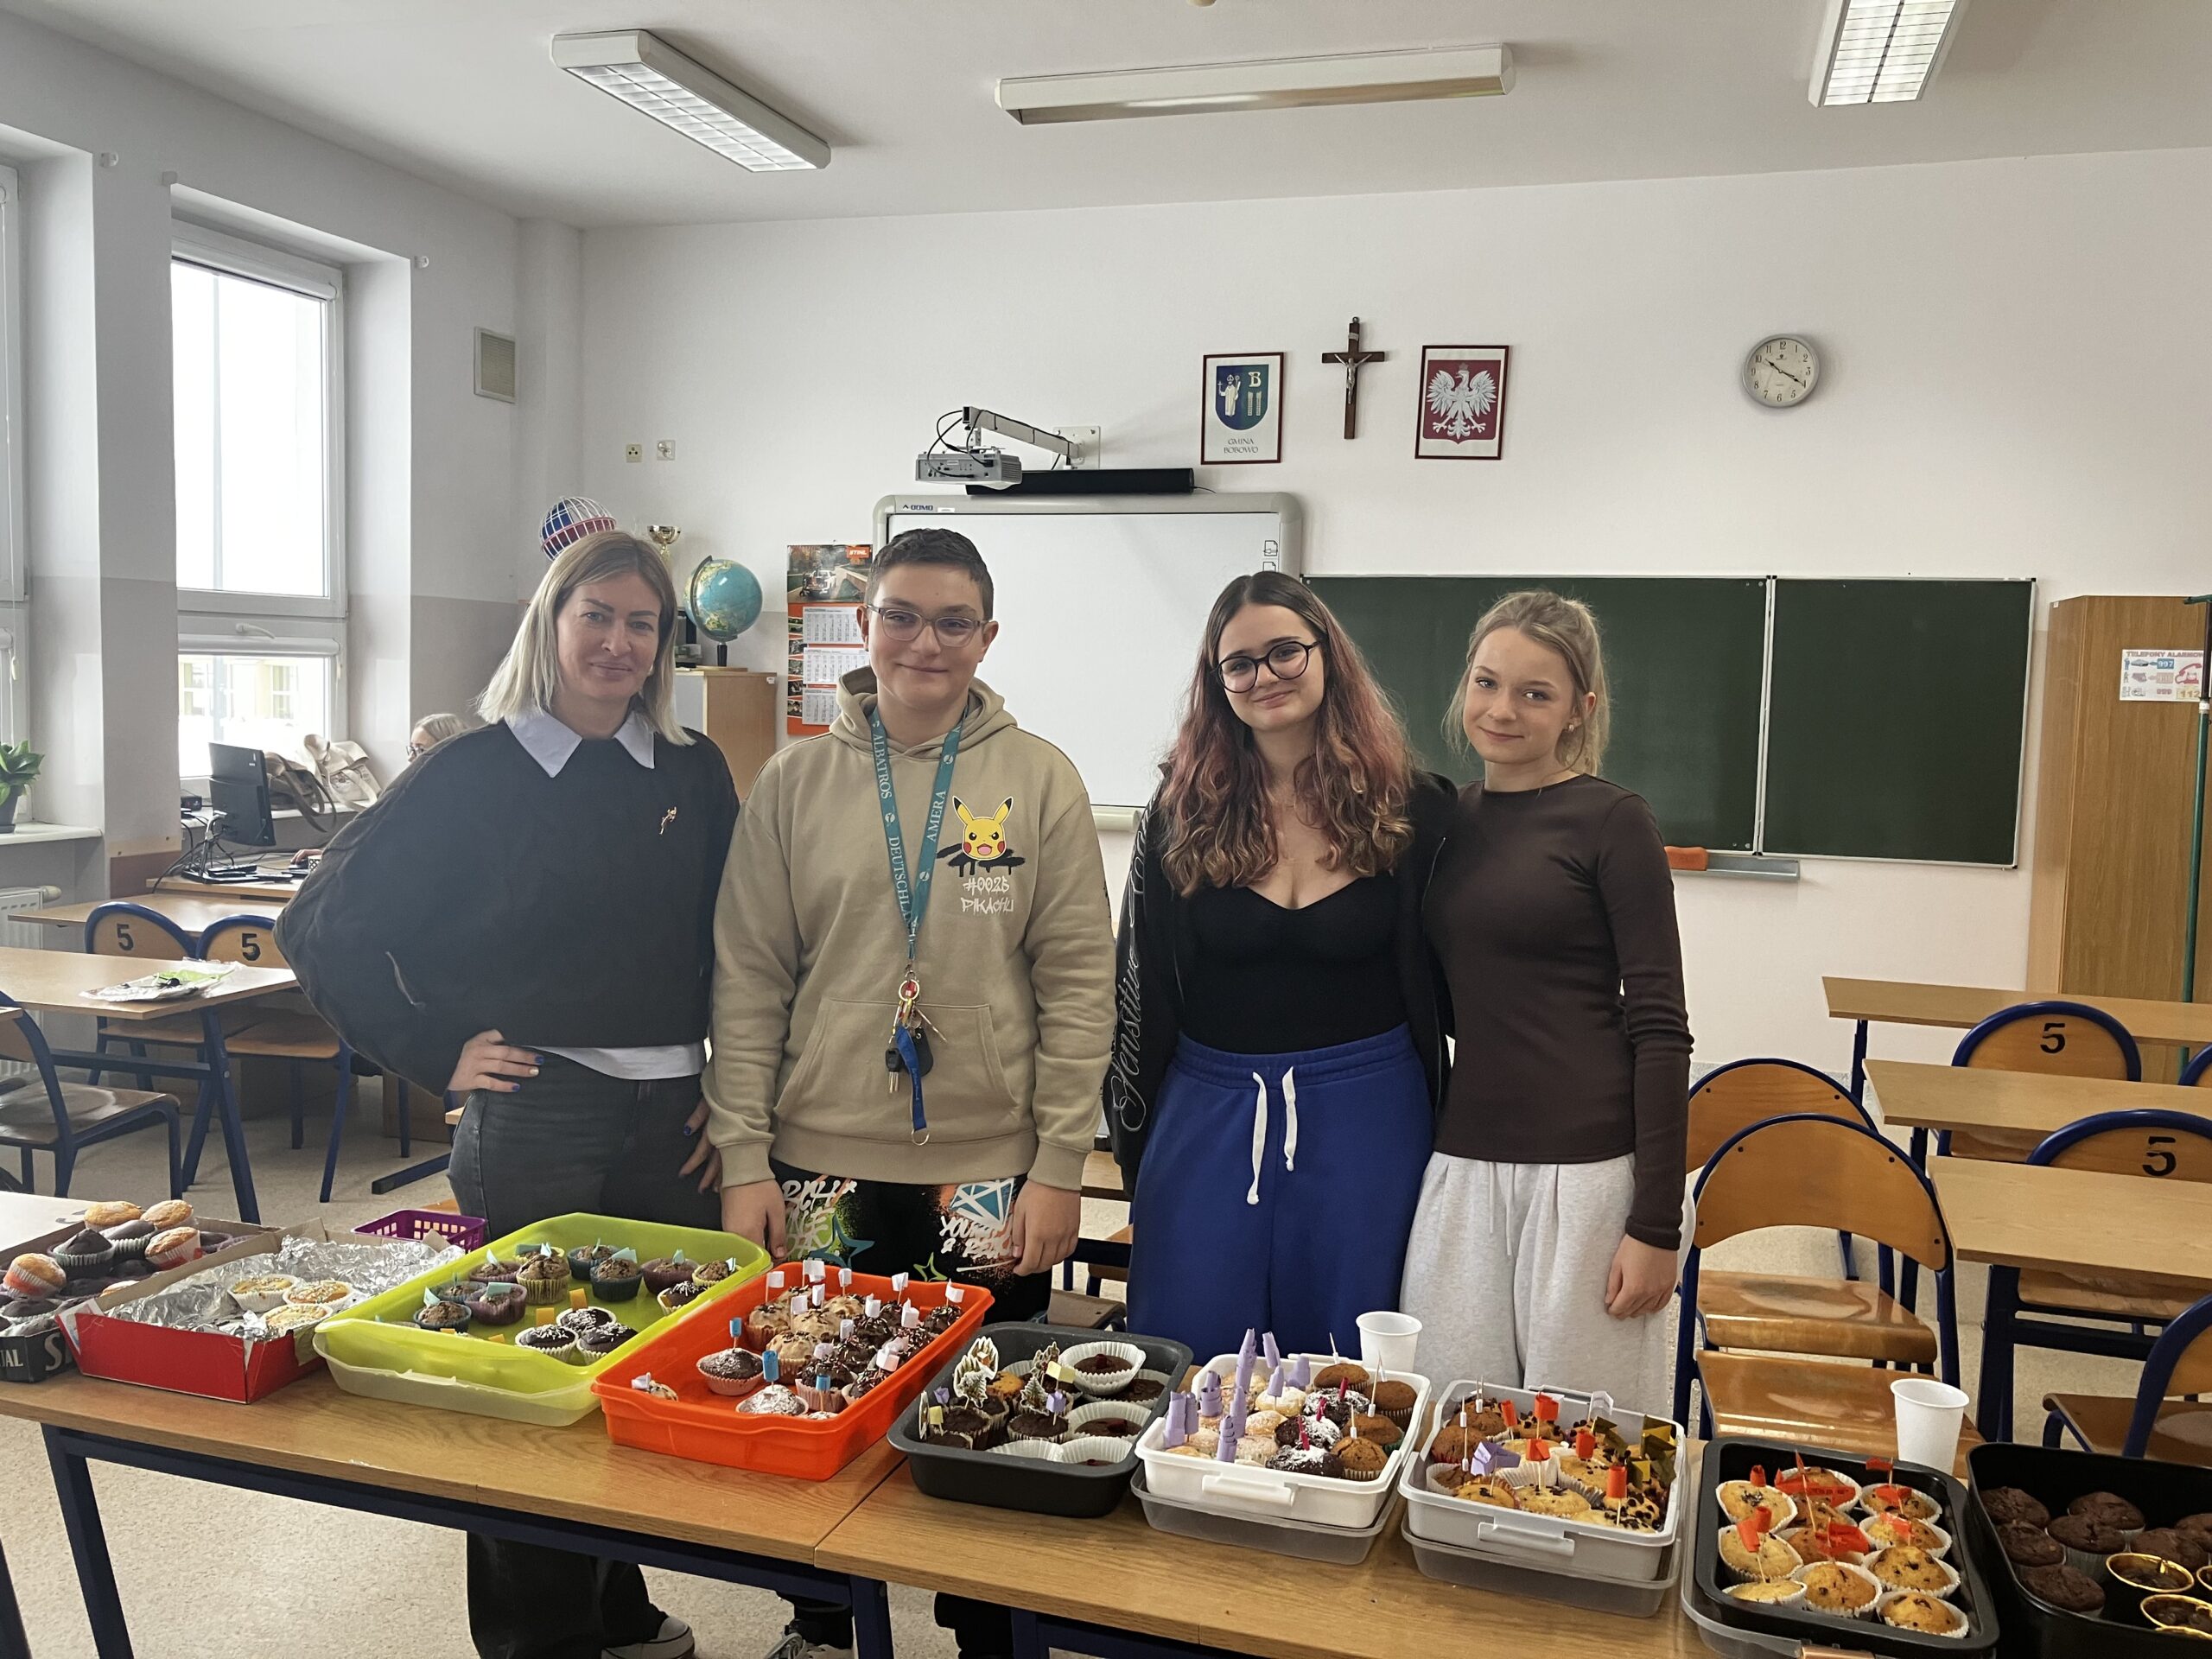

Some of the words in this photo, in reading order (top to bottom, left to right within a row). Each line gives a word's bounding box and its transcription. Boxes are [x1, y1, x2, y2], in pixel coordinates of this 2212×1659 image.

[1765, 345, 1771, 353] 11
[1780, 341, 1787, 350] 12
[1802, 353, 1808, 362] 2
[1805, 366, 1811, 376] 3
[1248, 371, 1262, 388] B
[1754, 380, 1759, 389] 8
[1764, 390, 1769, 398] 7
[1790, 390, 1796, 398] 5
[873, 734, 893, 799] ALBATROS
[926, 790, 946, 843] AMERA
[116, 923, 135, 951] 5
[241, 932, 262, 962] 5
[2039, 1022, 2066, 1054] 5
[2141, 1135, 2177, 1177] 5
